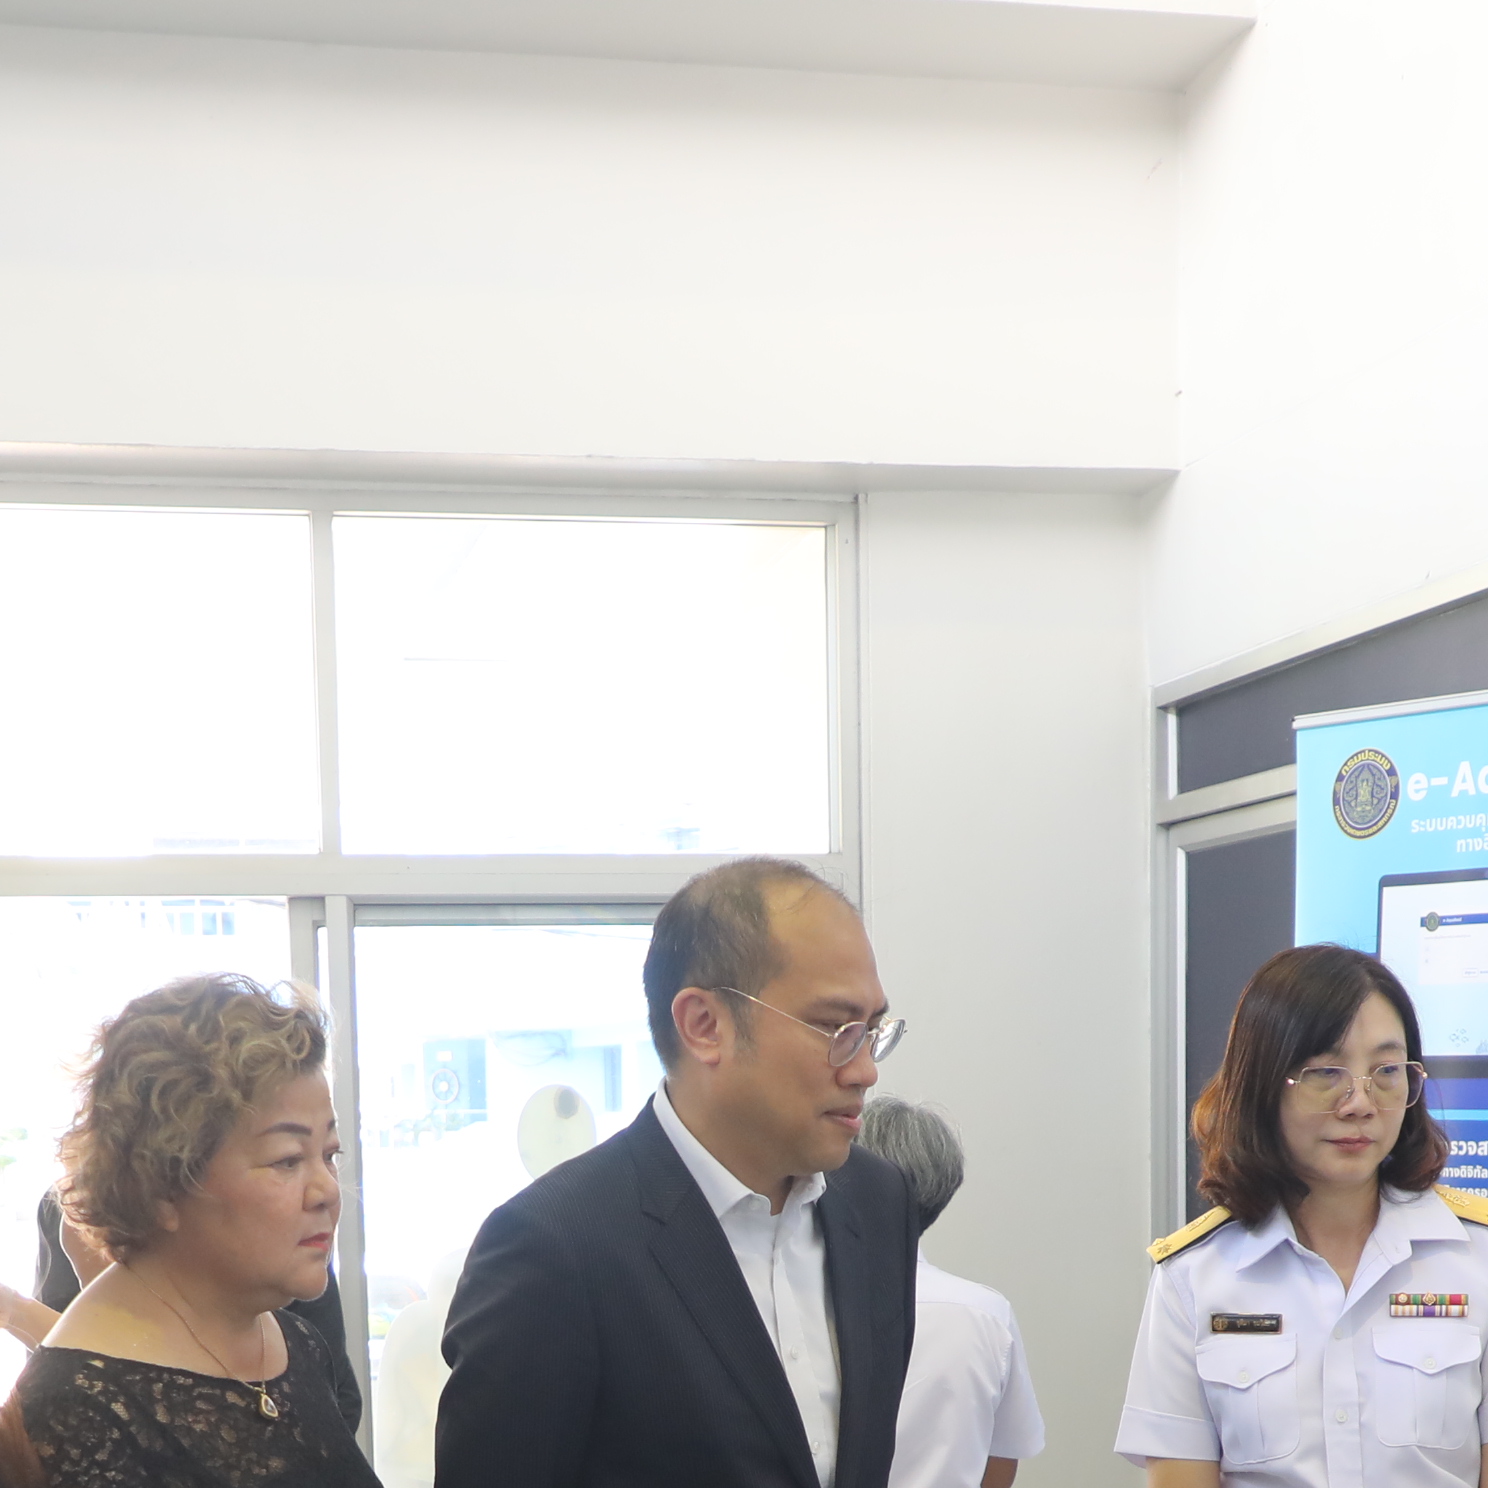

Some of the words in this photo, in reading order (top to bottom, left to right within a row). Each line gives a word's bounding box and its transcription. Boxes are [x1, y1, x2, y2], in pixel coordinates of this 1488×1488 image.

[1341, 750, 1391, 776] กรมประมง
[1441, 1165, 1488, 1179] ทางดิจิทัล
